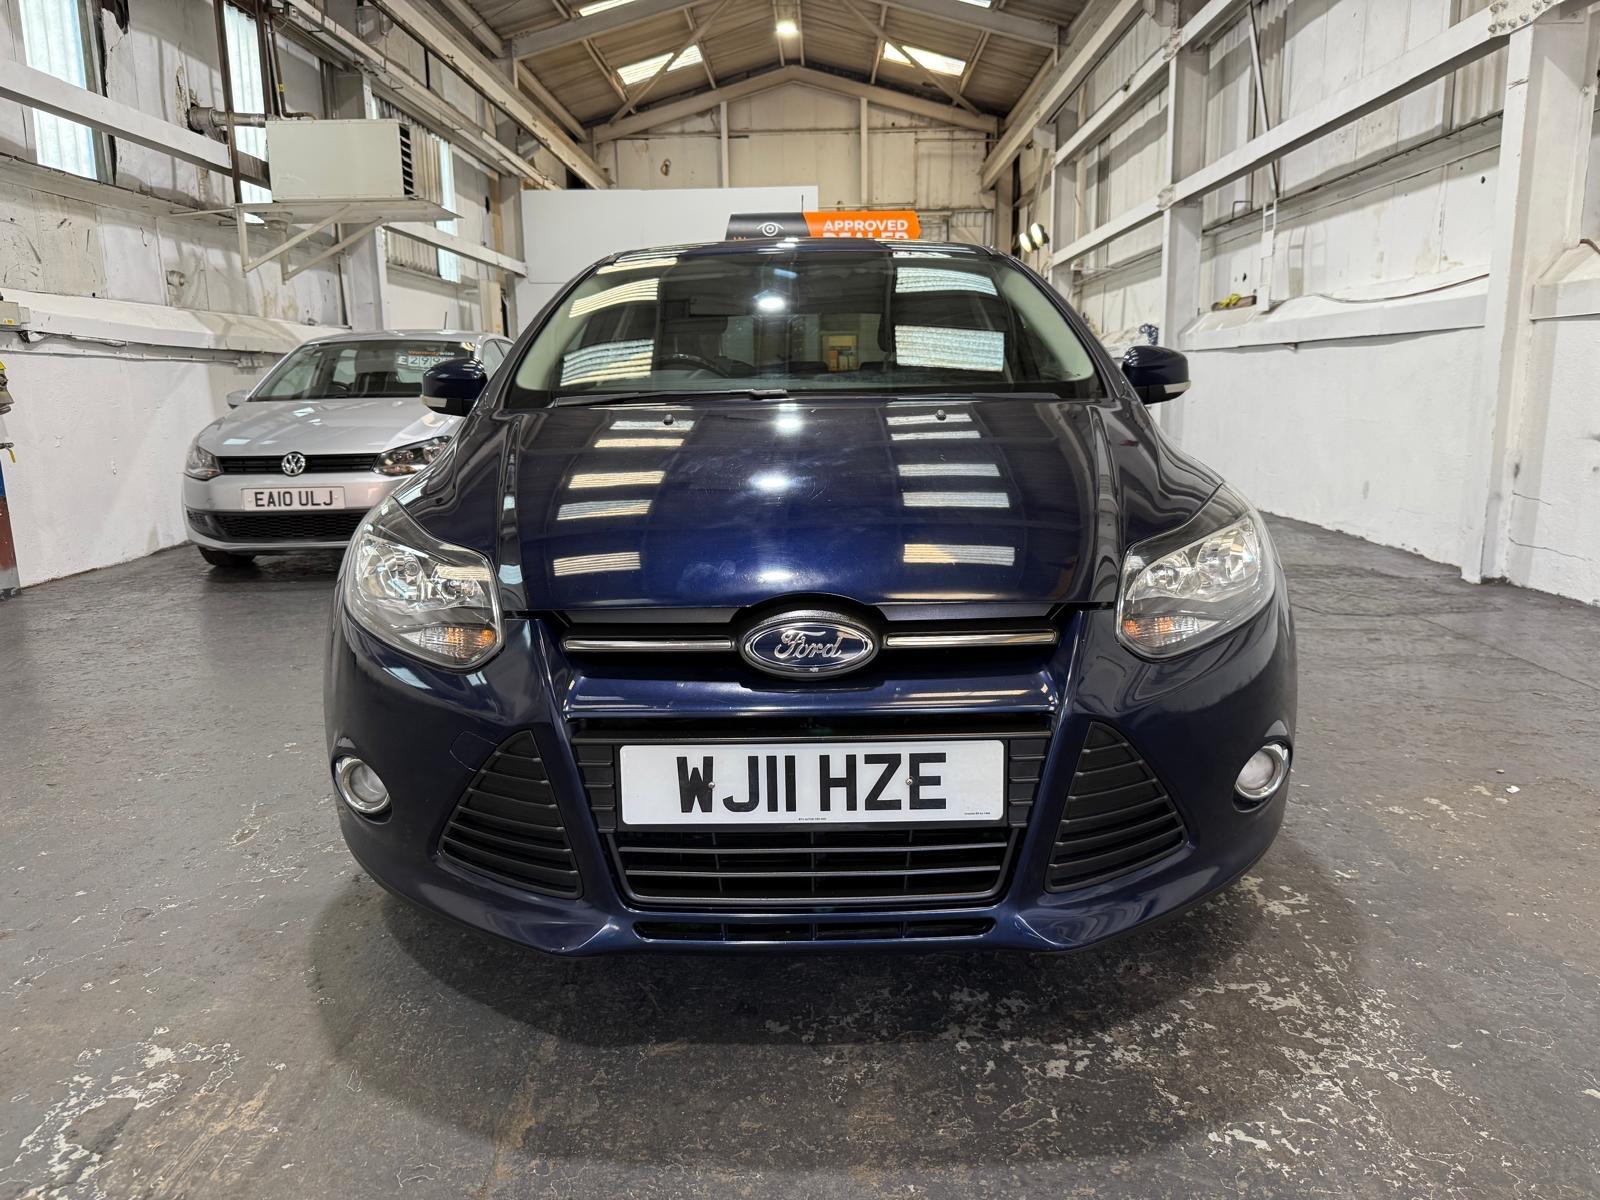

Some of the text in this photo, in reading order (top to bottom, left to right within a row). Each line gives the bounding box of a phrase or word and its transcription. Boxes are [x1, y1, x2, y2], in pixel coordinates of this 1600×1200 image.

[823, 220, 908, 231] APPROVED
[254, 490, 333, 507] EA10 ULJ
[774, 629, 842, 659] Ford
[676, 752, 947, 813] WJ11 HZE
